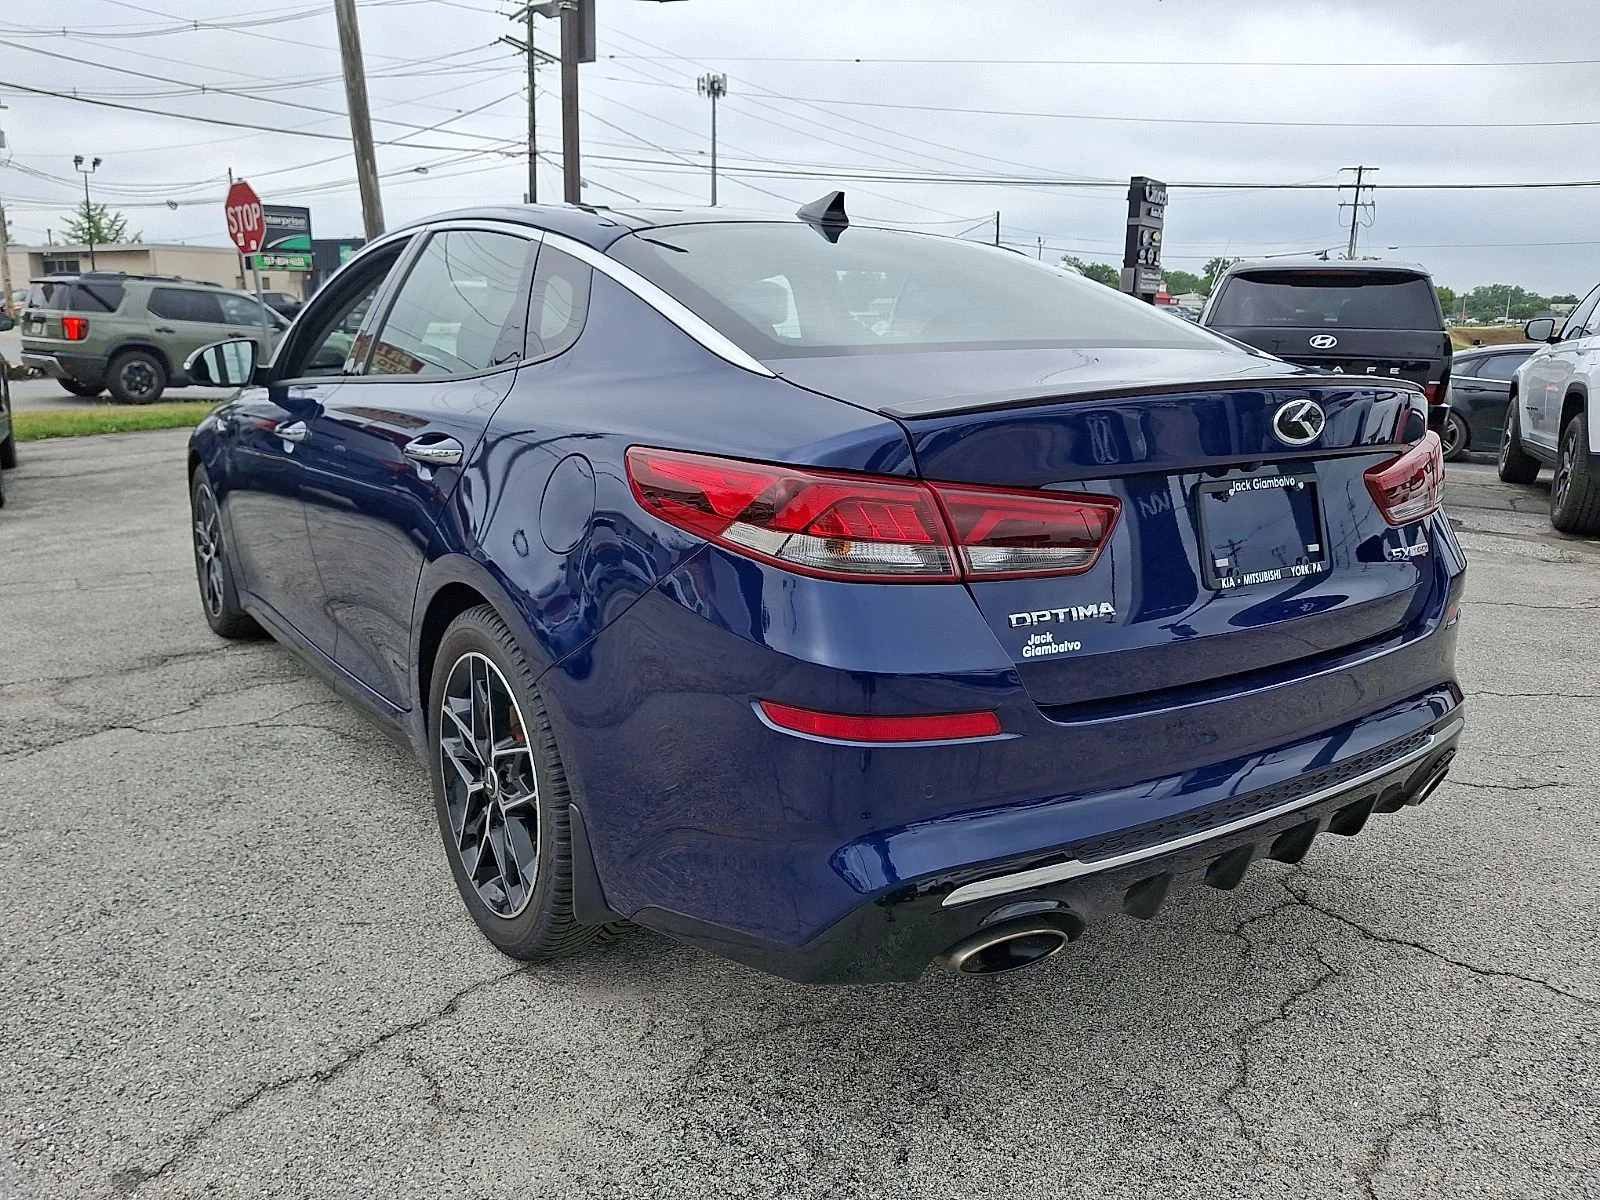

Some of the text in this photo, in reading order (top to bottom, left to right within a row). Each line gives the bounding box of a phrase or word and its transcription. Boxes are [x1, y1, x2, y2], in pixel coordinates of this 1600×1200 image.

[227, 203, 261, 234] STOP
[264, 215, 306, 227] nterprise
[1232, 476, 1296, 492] Jack Giambalvo
[1221, 578, 1236, 589] KIA
[1243, 570, 1281, 585] MITSUBISHI
[1312, 562, 1323, 573] PA
[1008, 602, 1116, 628] OPTIMA
[1027, 631, 1054, 646] Jack
[1022, 640, 1082, 658] Giambalvo
